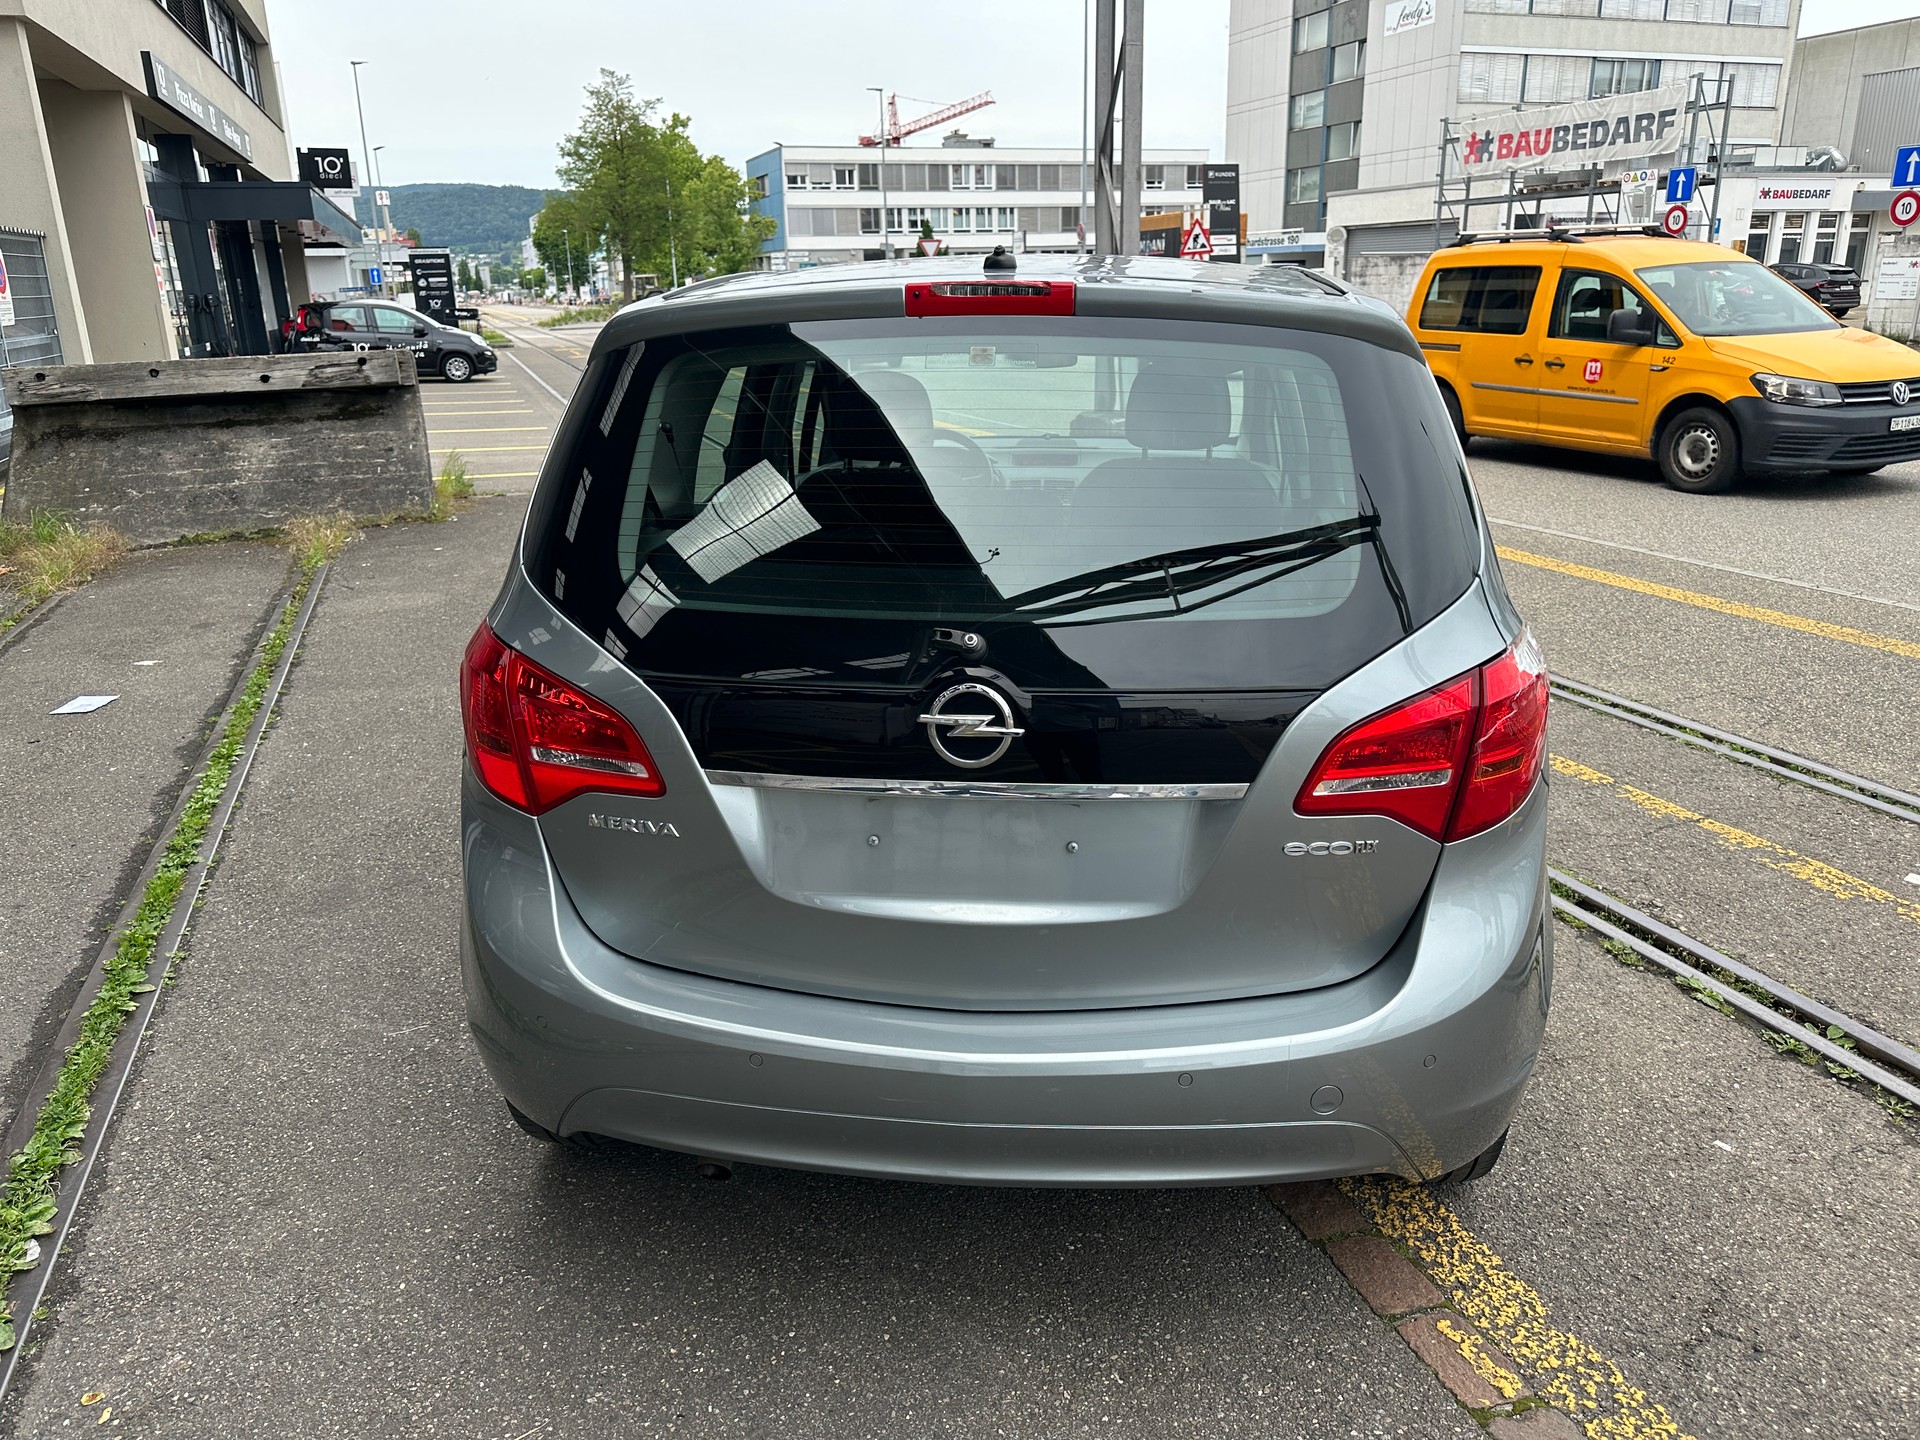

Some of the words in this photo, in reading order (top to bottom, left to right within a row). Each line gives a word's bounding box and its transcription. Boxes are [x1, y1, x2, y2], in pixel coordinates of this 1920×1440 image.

[1496, 108, 1677, 160] BAUBEDARF
[1772, 189, 1831, 199] BAUBEDARF
[1901, 202, 1912, 215] 10
[1672, 214, 1680, 226] 10
[1287, 235, 1300, 245] 190
[1662, 356, 1676, 365] 142
[588, 813, 680, 838] MERIVA
